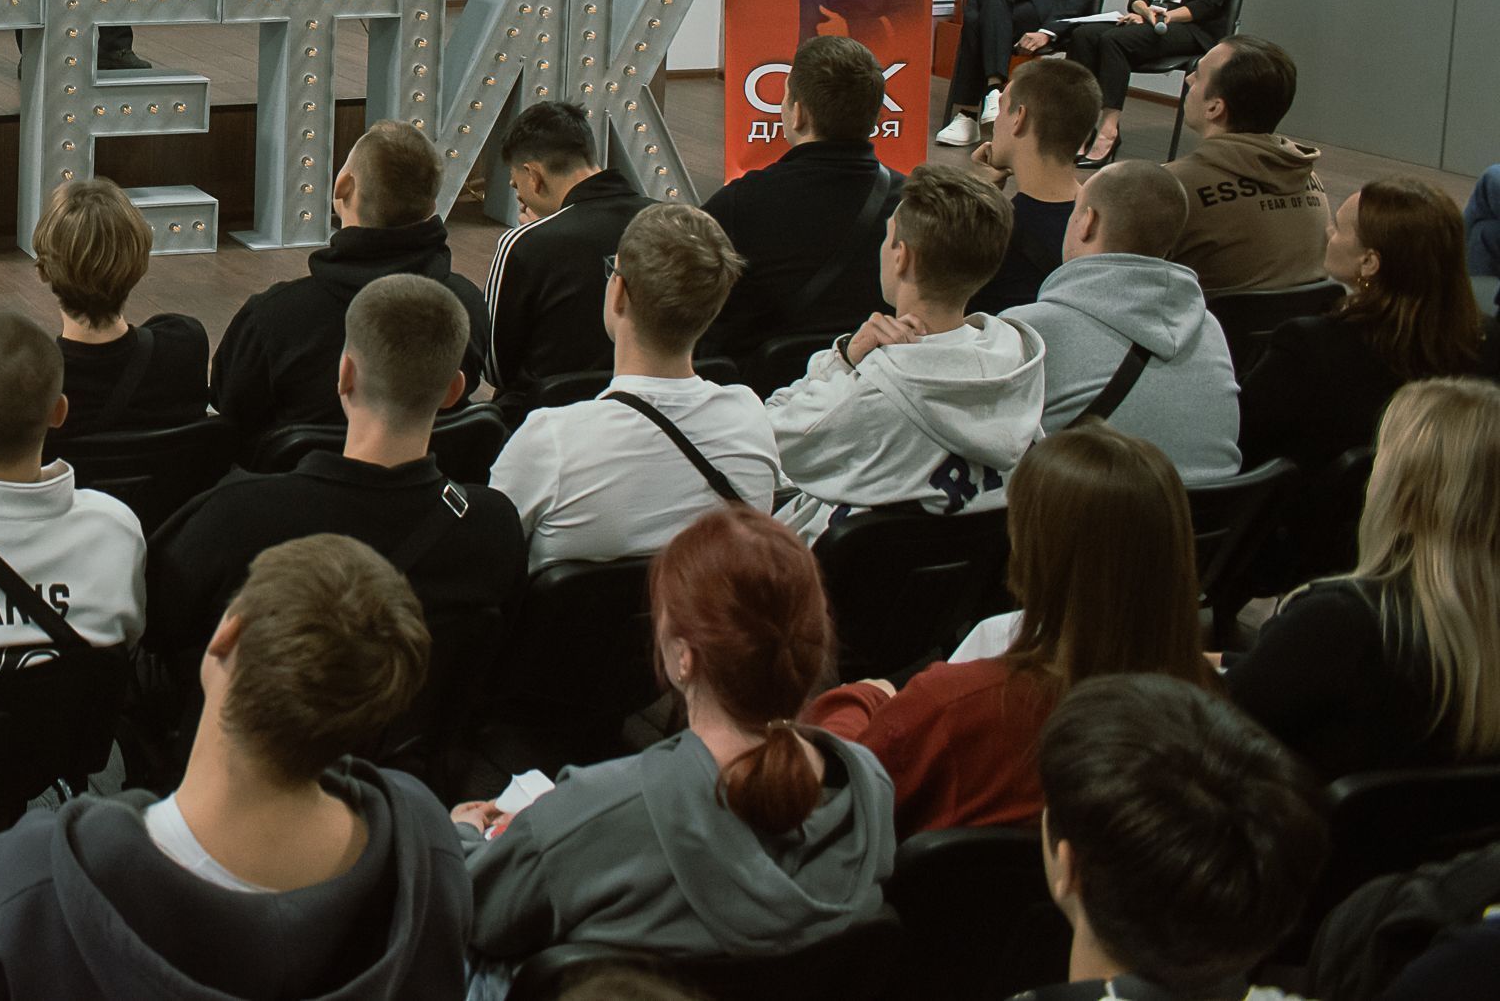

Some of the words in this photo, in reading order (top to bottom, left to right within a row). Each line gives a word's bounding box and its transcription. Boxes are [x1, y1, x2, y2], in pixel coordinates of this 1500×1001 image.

[1260, 198, 1287, 211] FEAR
[1291, 197, 1303, 208] OF
[1306, 196, 1321, 207] GOD
